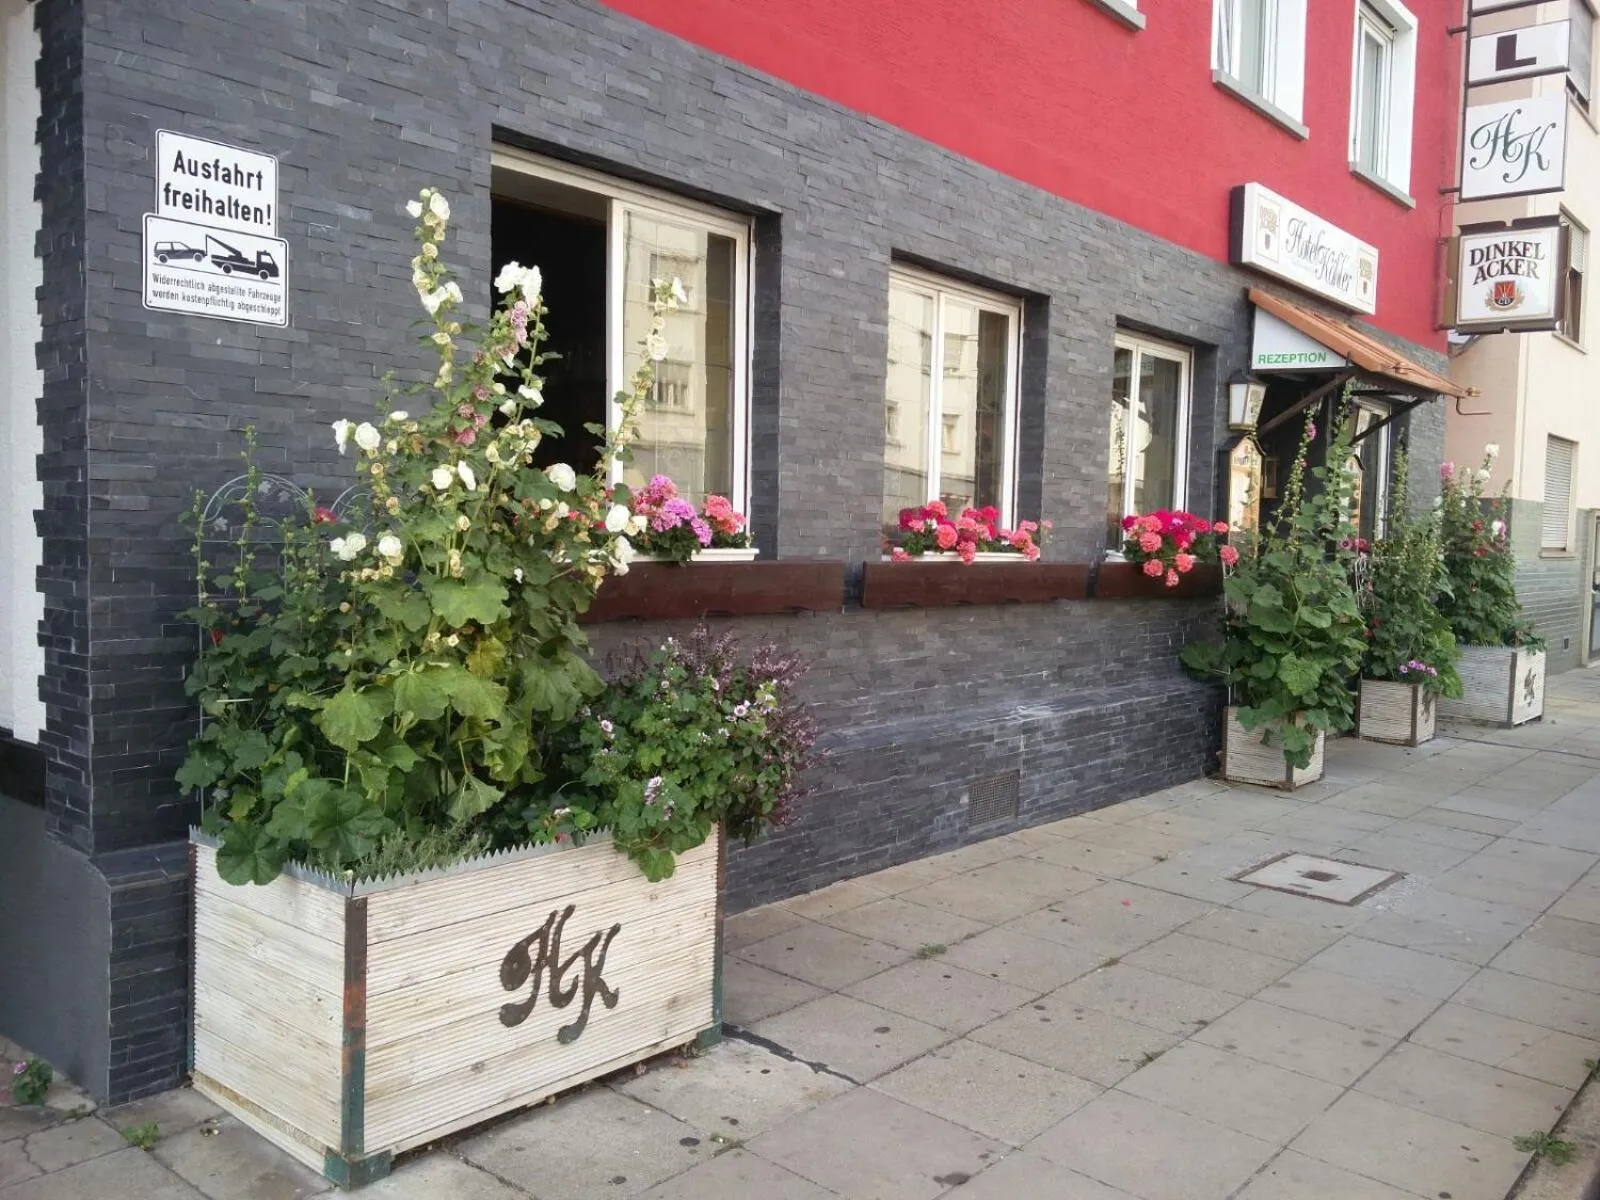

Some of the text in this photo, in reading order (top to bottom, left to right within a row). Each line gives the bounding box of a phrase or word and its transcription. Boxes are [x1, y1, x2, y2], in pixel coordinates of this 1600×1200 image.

[1469, 108, 1556, 184] HK
[173, 150, 263, 191] Ausfahrt
[163, 182, 271, 226] freihalten!
[1285, 218, 1325, 264] Hotel
[1469, 240, 1546, 267] DINKEL
[152, 272, 281, 304] Widerrechtlich abgestellte Fahrzeuge
[1472, 258, 1541, 286] ACKER
[151, 289, 179, 301] werden
[181, 292, 235, 311] kostenpflichtig
[1257, 351, 1328, 365] REZEPTION
[499, 904, 621, 1045] HK
